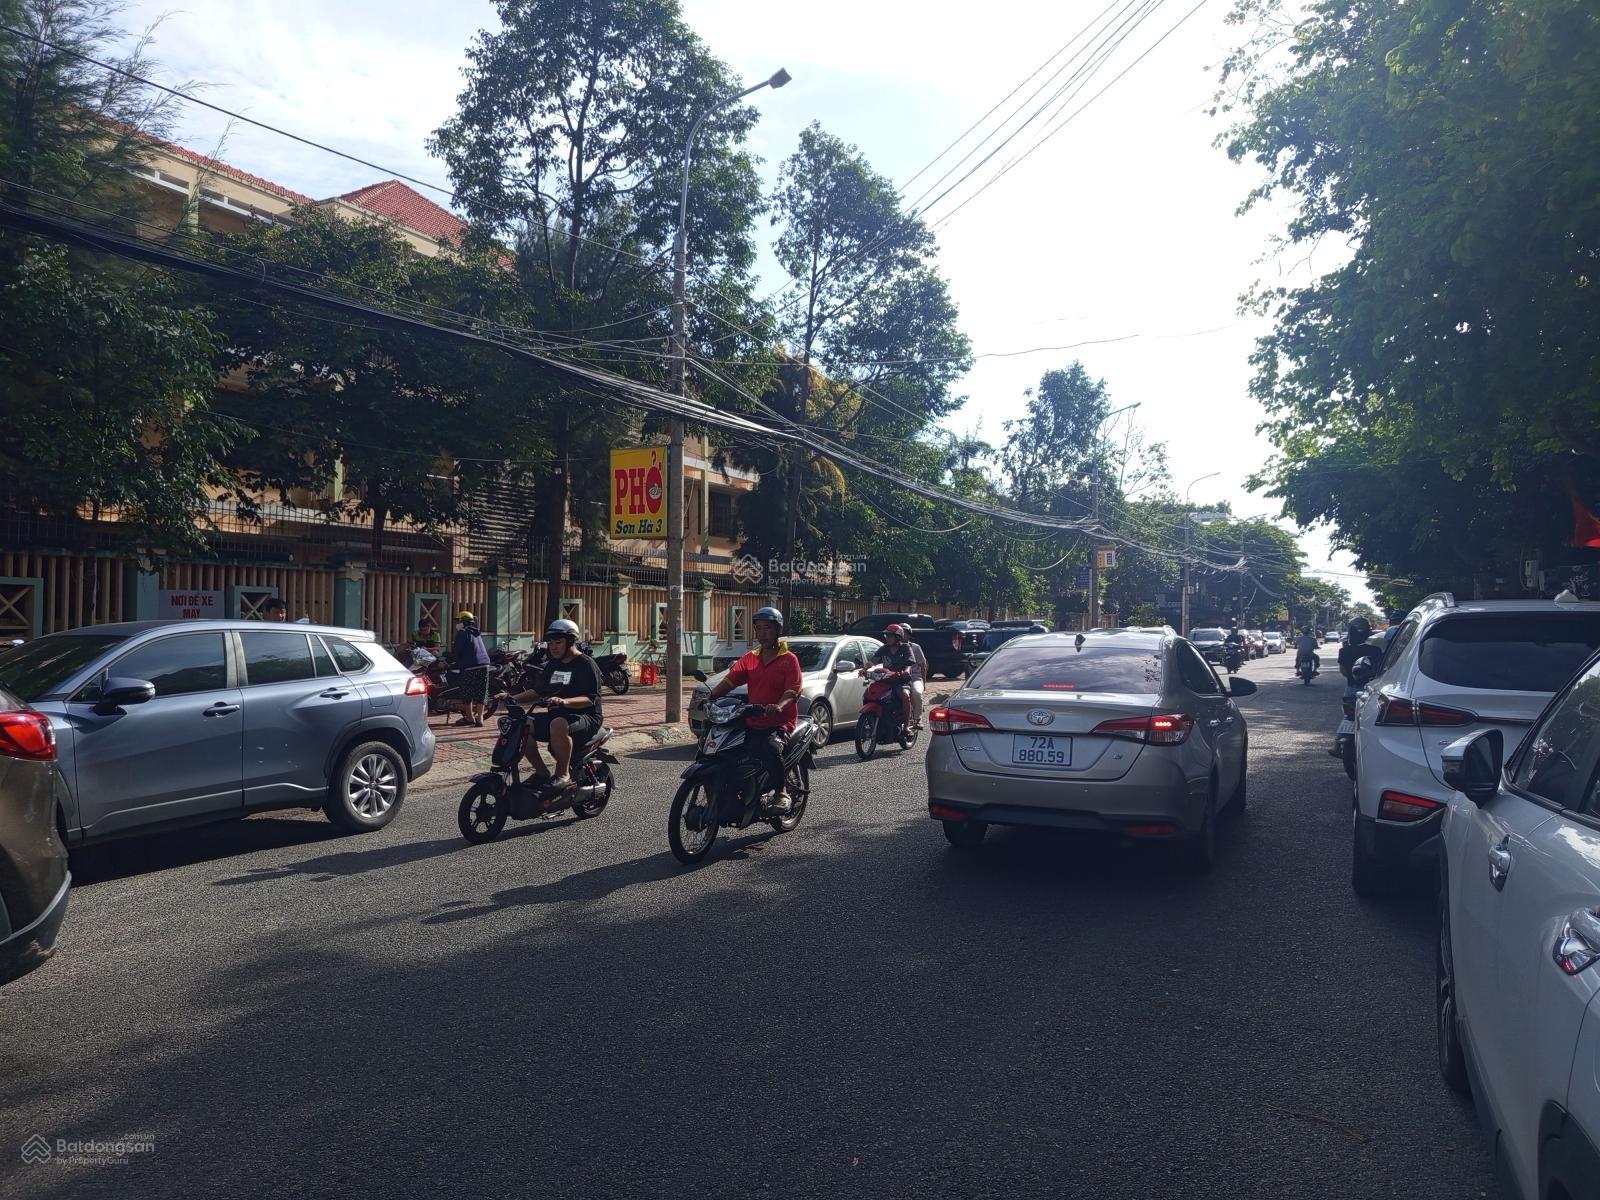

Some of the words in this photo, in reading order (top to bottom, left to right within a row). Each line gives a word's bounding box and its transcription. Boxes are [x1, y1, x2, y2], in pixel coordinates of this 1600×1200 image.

[614, 450, 663, 515] PHỞ
[655, 519, 663, 533] 3
[202, 596, 214, 606] XE
[1030, 736, 1055, 750] 72A
[1018, 750, 1065, 763] 880.59
